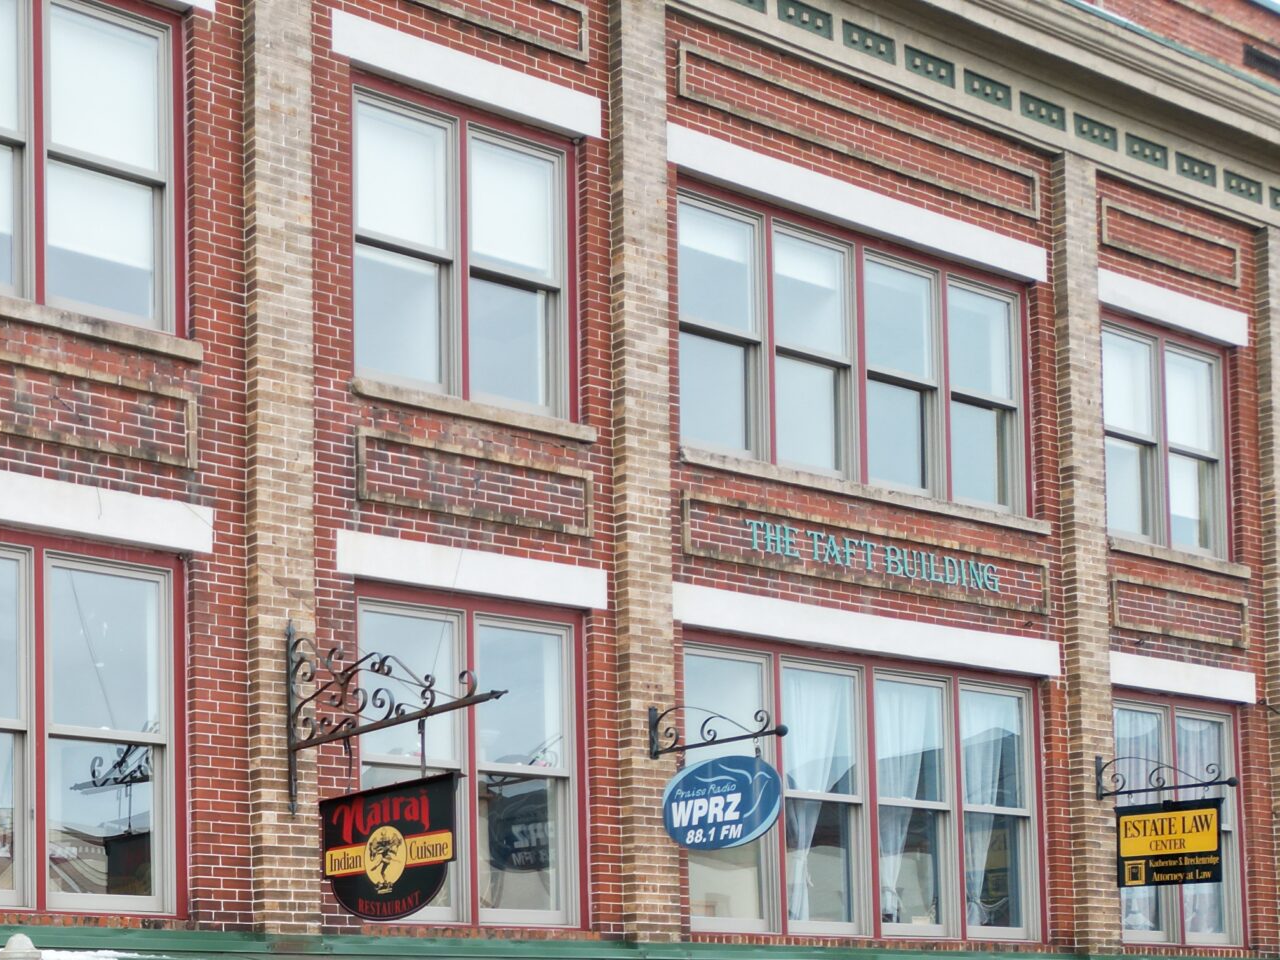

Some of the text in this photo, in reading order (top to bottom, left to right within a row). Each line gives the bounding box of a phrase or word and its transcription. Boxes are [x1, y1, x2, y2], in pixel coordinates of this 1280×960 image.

[745, 518, 1001, 593] THE TAFT BUILDING
[674, 782, 737, 800] Praise Radio
[332, 789, 430, 844] Natraj
[671, 793, 742, 828] WPRZ
[685, 823, 743, 845] 88.1 FM
[1124, 813, 1214, 838] ESTATE LAW
[330, 840, 449, 872] Indian Cuisine
[1149, 838, 1186, 852] CENTER
[1152, 868, 1212, 882] Attorney at Law
[358, 890, 421, 916] RESTAURANT
